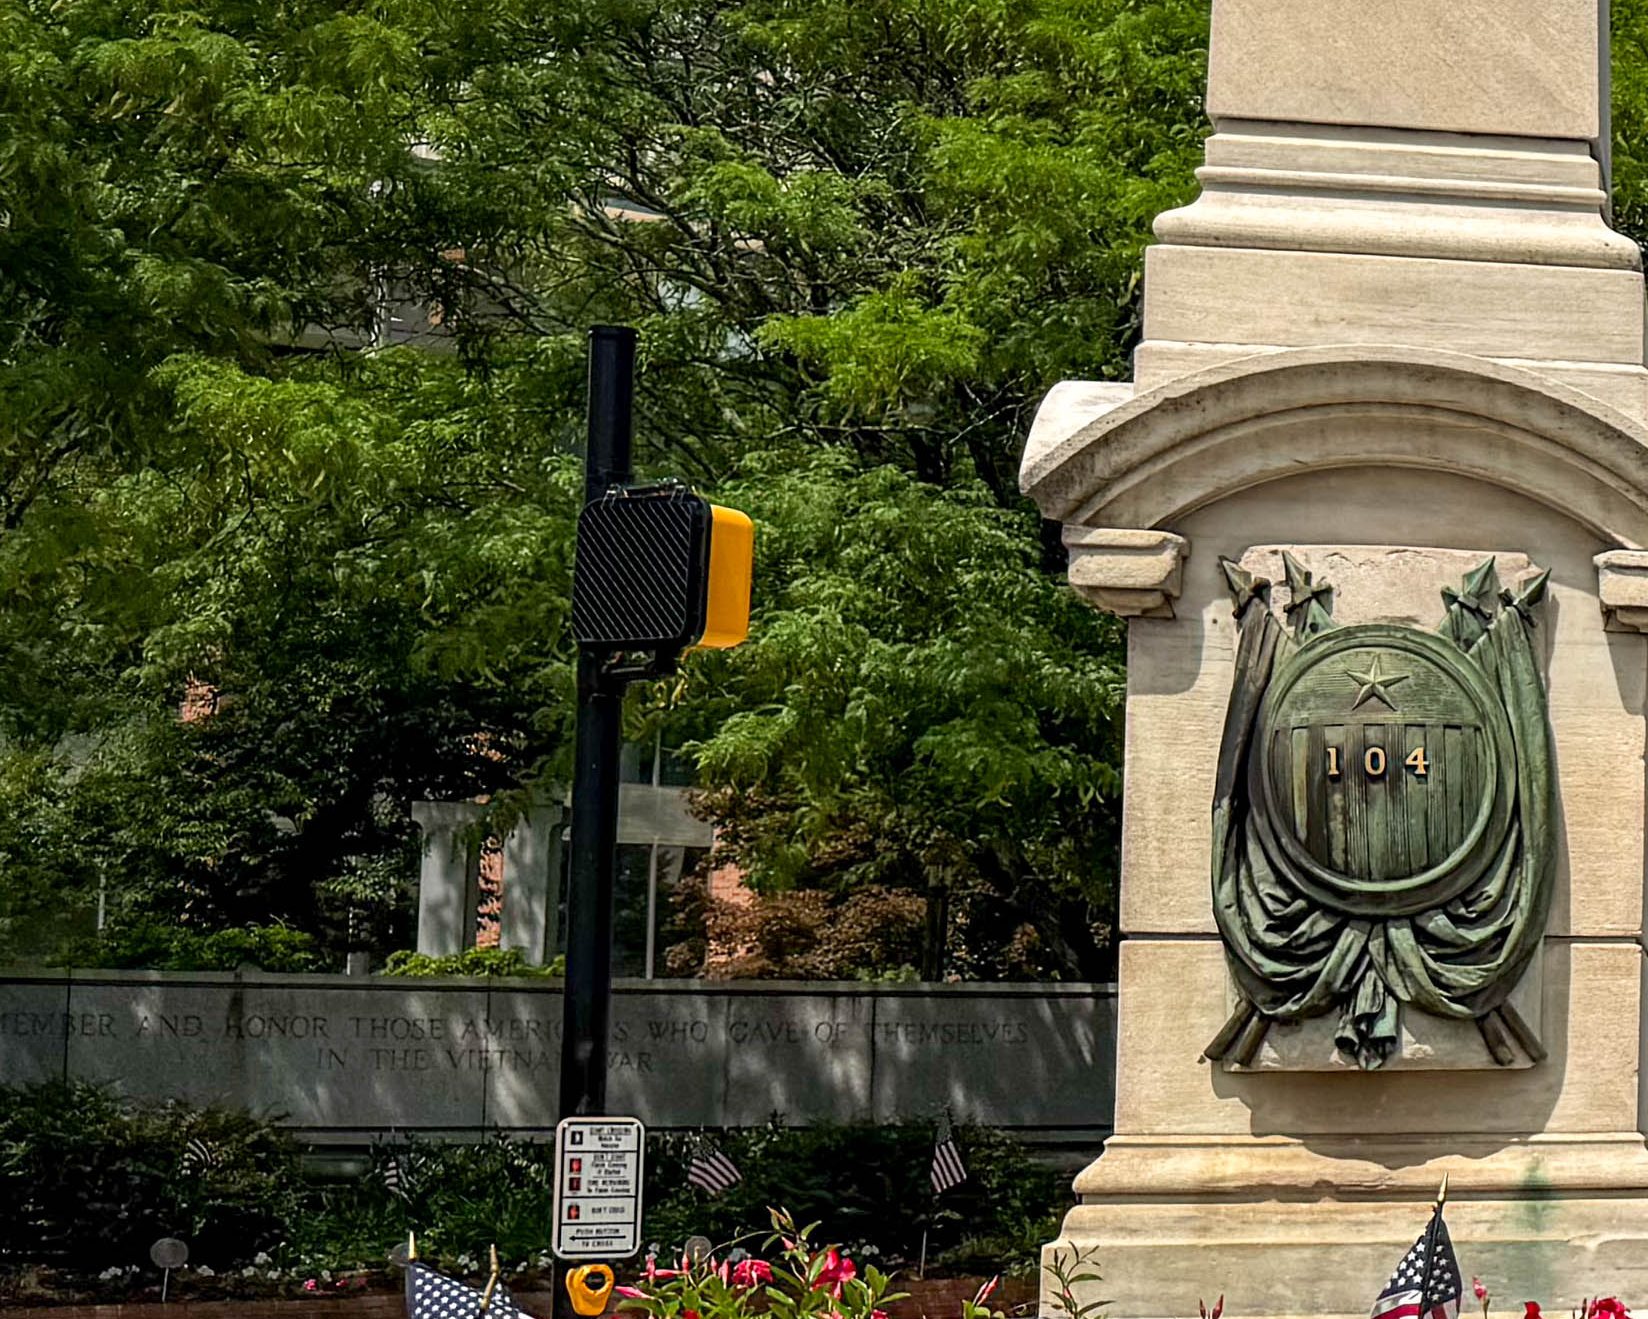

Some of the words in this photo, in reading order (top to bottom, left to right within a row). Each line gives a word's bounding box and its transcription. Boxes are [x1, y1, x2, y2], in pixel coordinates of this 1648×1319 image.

[135, 1014, 203, 1038] AND
[224, 1015, 329, 1040] HONOR
[348, 1017, 445, 1041] THOSE
[648, 1020, 709, 1043] WHO
[729, 1020, 801, 1044] GAVE
[814, 1021, 848, 1044] OF
[867, 1021, 1029, 1045] THEMSELVES
[315, 1048, 348, 1070] IN
[368, 1048, 430, 1071] THE
[446, 1049, 561, 1072] VIETNA
